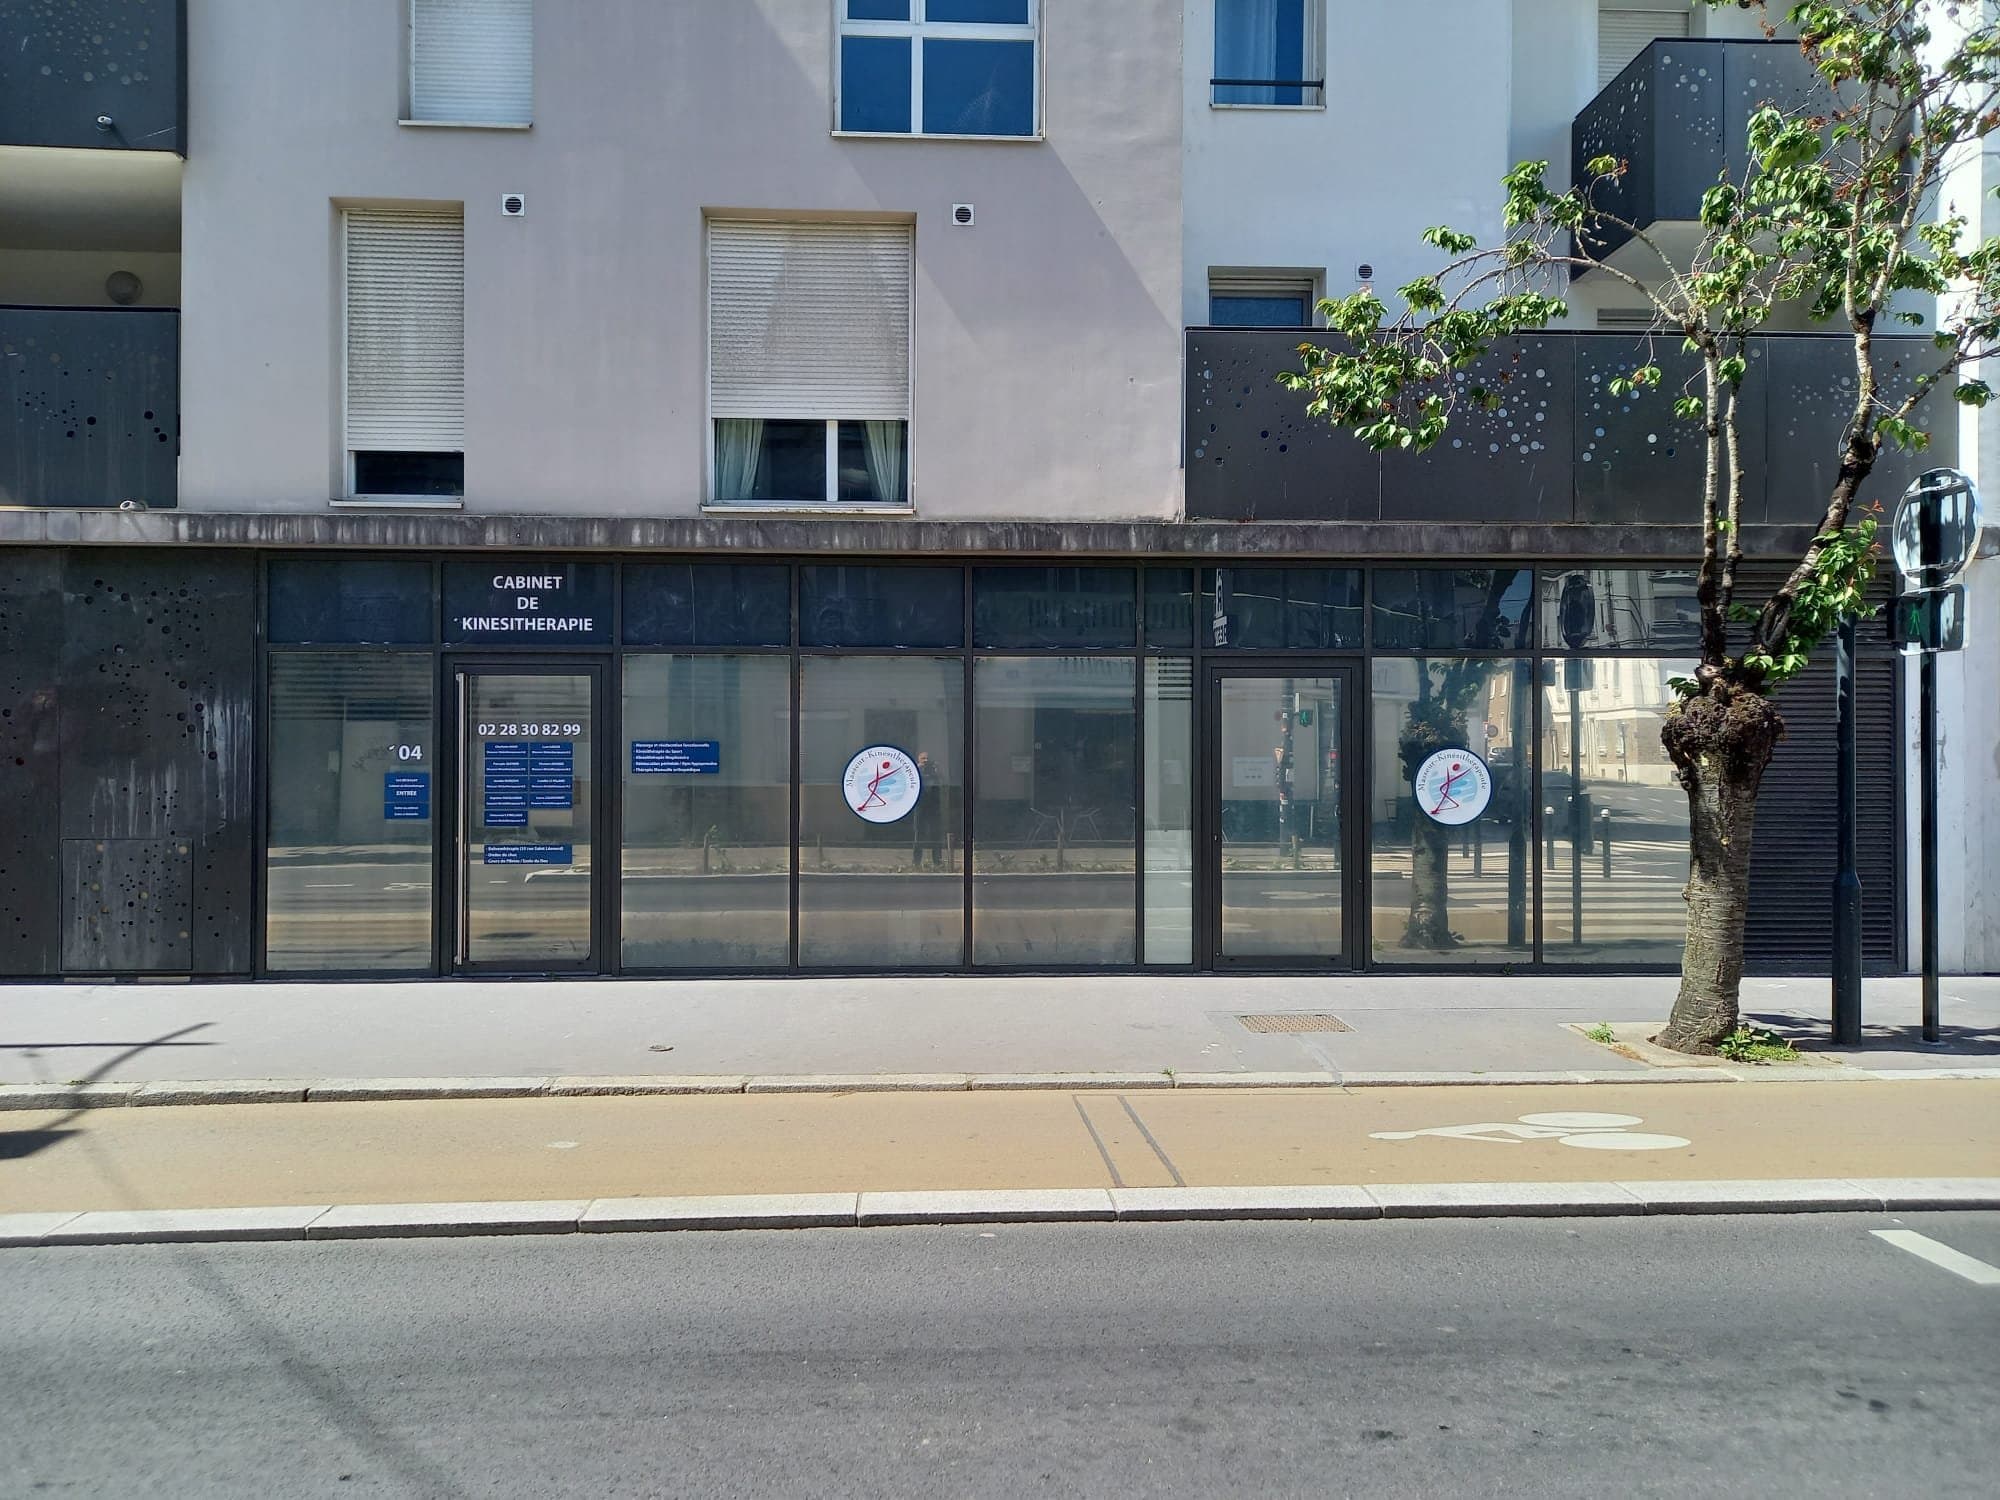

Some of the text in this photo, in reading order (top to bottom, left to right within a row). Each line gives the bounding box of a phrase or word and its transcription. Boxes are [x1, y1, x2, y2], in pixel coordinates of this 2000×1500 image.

[492, 575, 563, 589] CABINET
[517, 597, 539, 610] DE
[462, 617, 593, 631] KINESITHERAPIE
[478, 724, 581, 736] 02 28 30 82 99
[398, 745, 422, 760] 04
